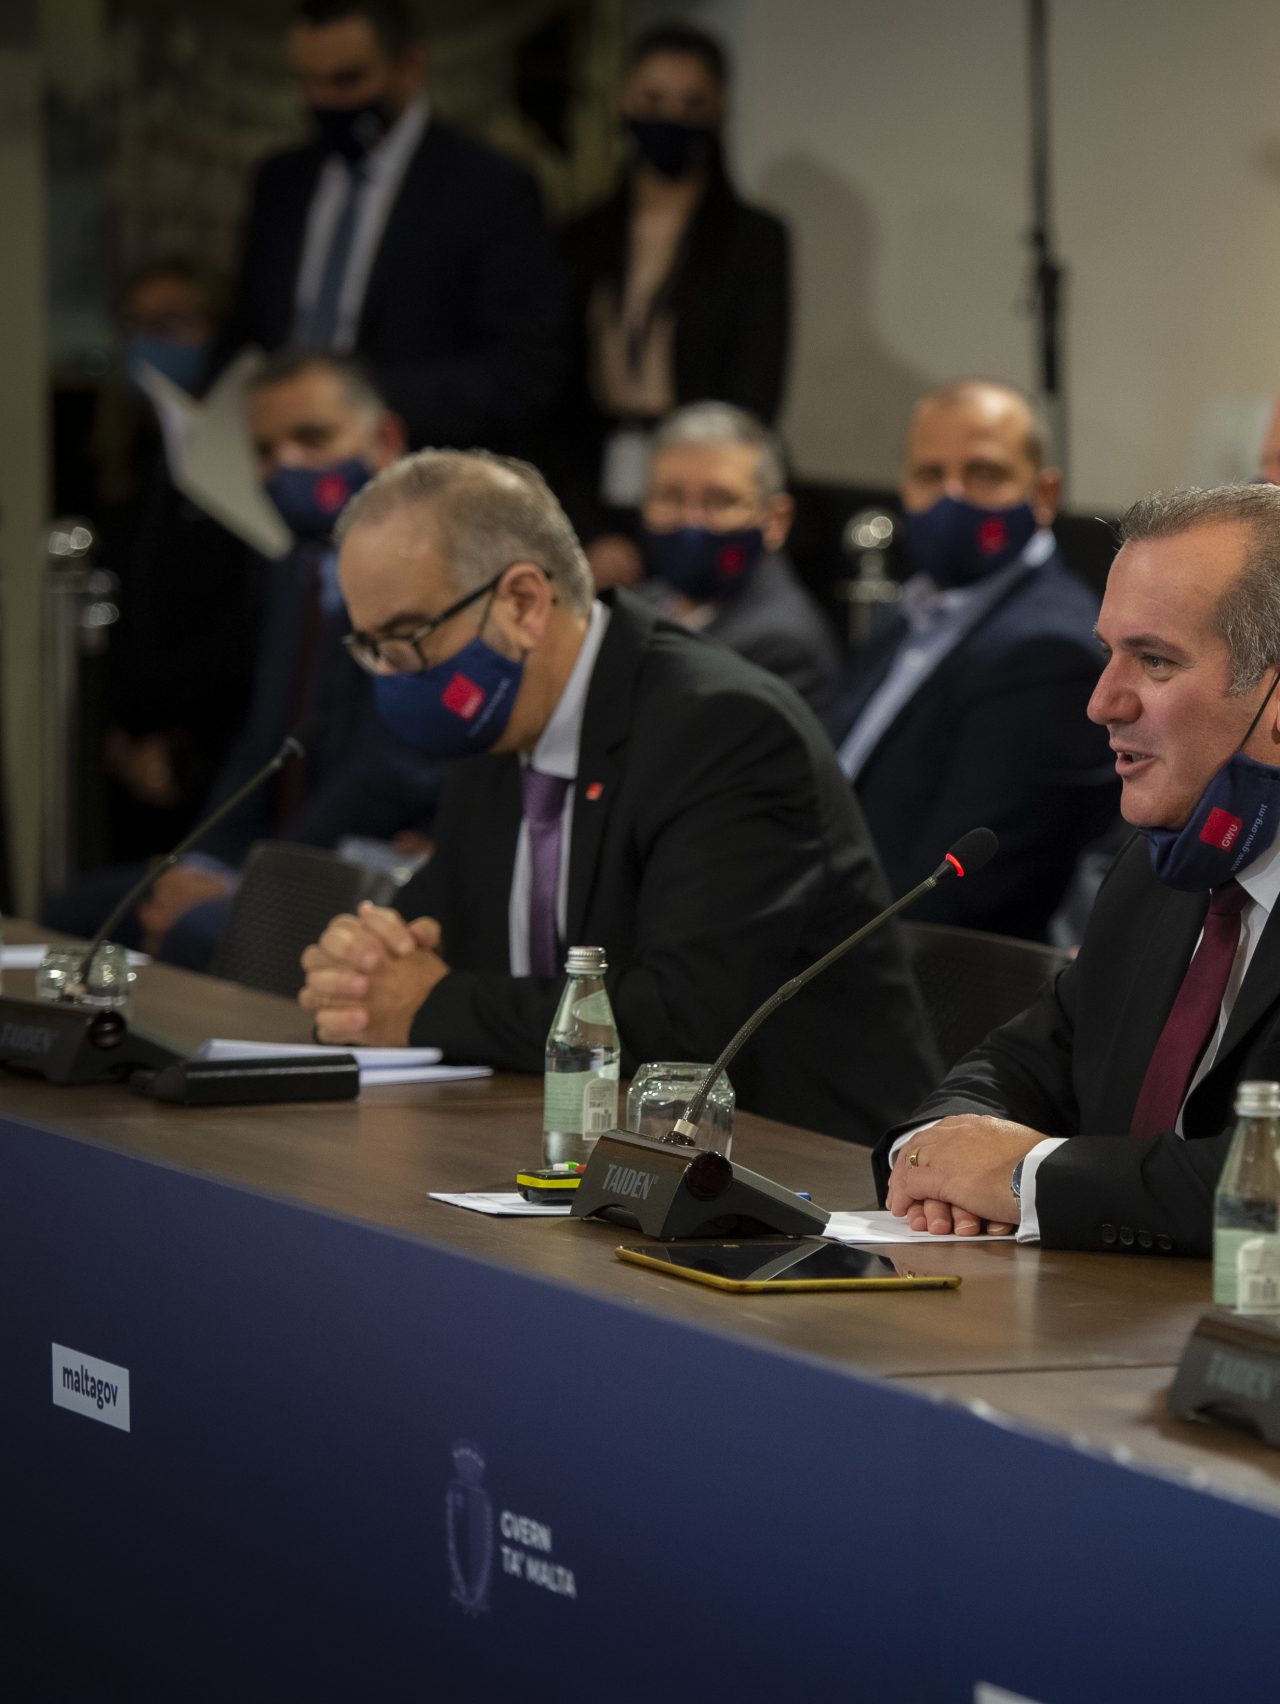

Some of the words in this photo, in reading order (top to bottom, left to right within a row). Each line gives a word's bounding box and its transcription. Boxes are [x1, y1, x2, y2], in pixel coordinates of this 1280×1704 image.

[1221, 823, 1238, 848] GWU
[1231, 803, 1268, 872] www.gwu.org.mt
[602, 1163, 655, 1200] TAIDEN
[62, 1364, 118, 1410] maltagov
[526, 1556, 577, 1599] MALTA
